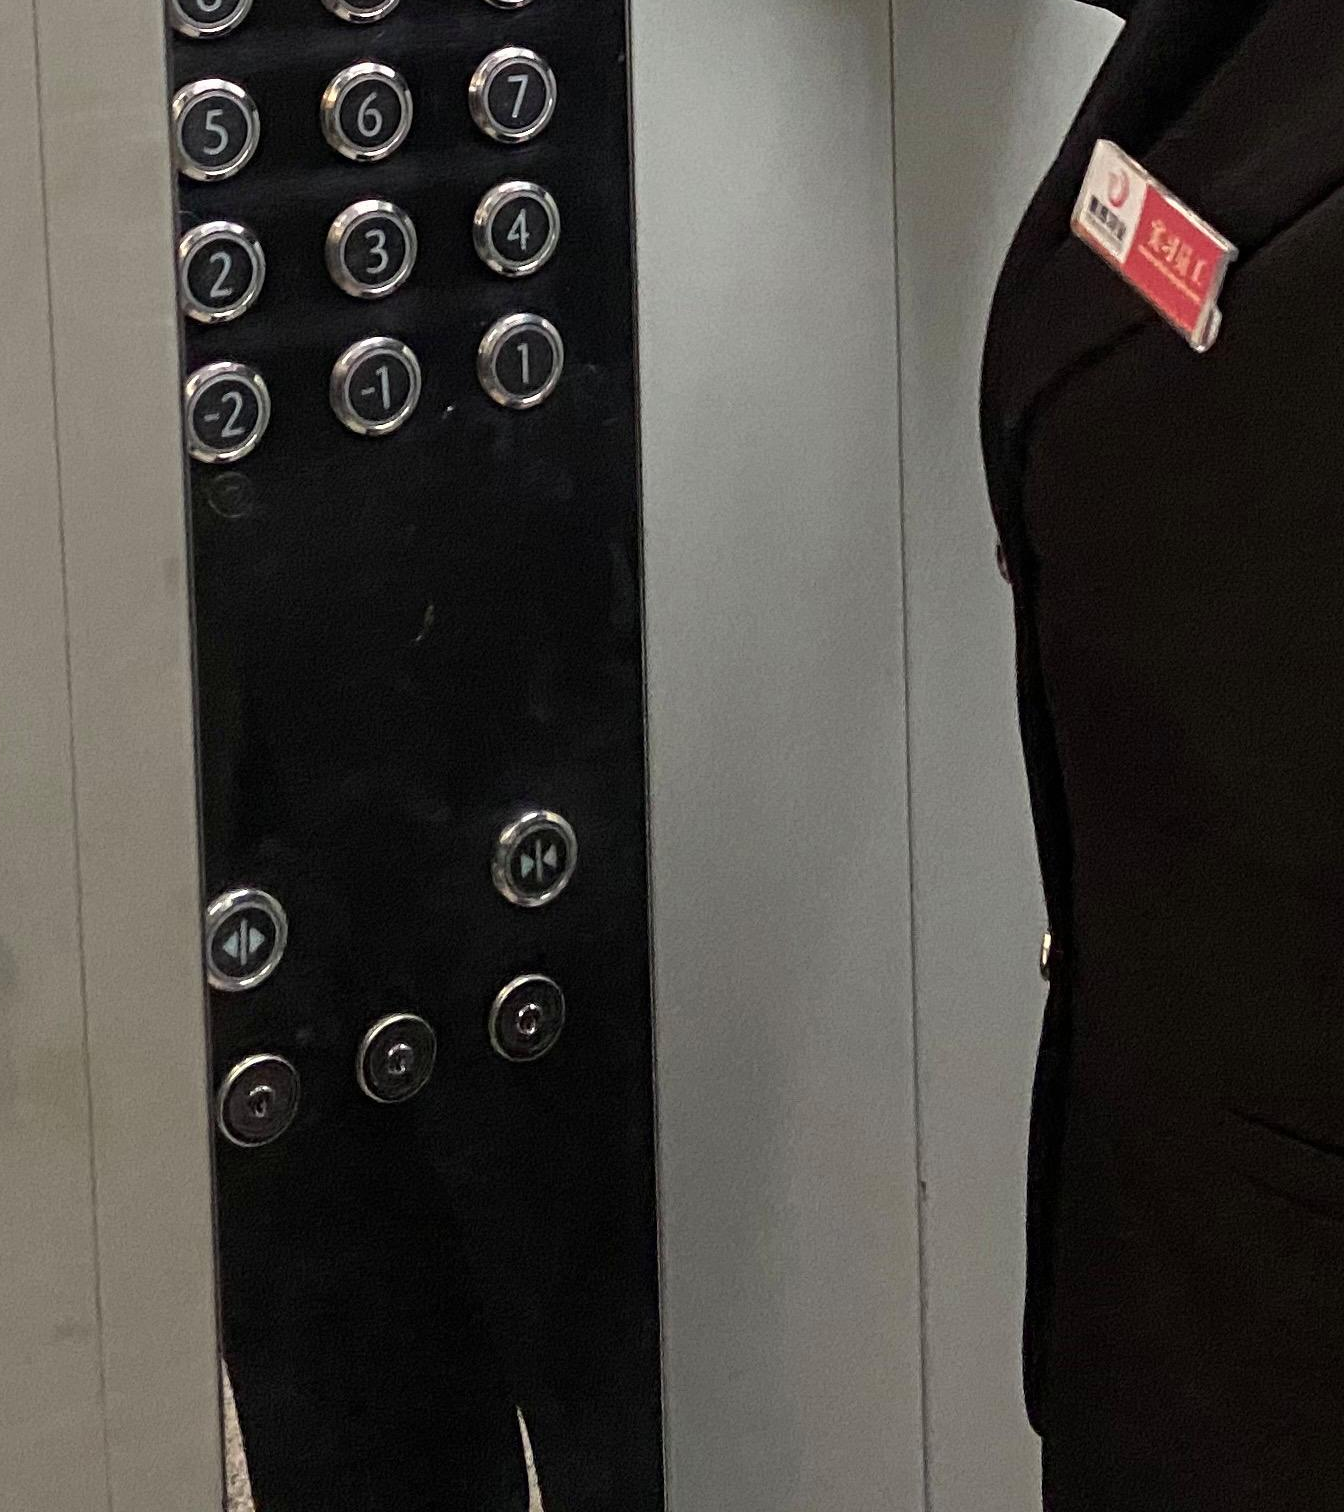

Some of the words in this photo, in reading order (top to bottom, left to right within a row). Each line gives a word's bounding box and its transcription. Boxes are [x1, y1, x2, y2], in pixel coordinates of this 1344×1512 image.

[356, 91, 383, 138] 6
[506, 73, 530, 119] 7
[202, 108, 230, 156] 5
[364, 228, 389, 275] 3
[506, 207, 530, 252] 4
[208, 251, 233, 299] 2
[516, 342, 531, 385] 1
[360, 365, 391, 410] -1
[203, 390, 246, 439] -2
